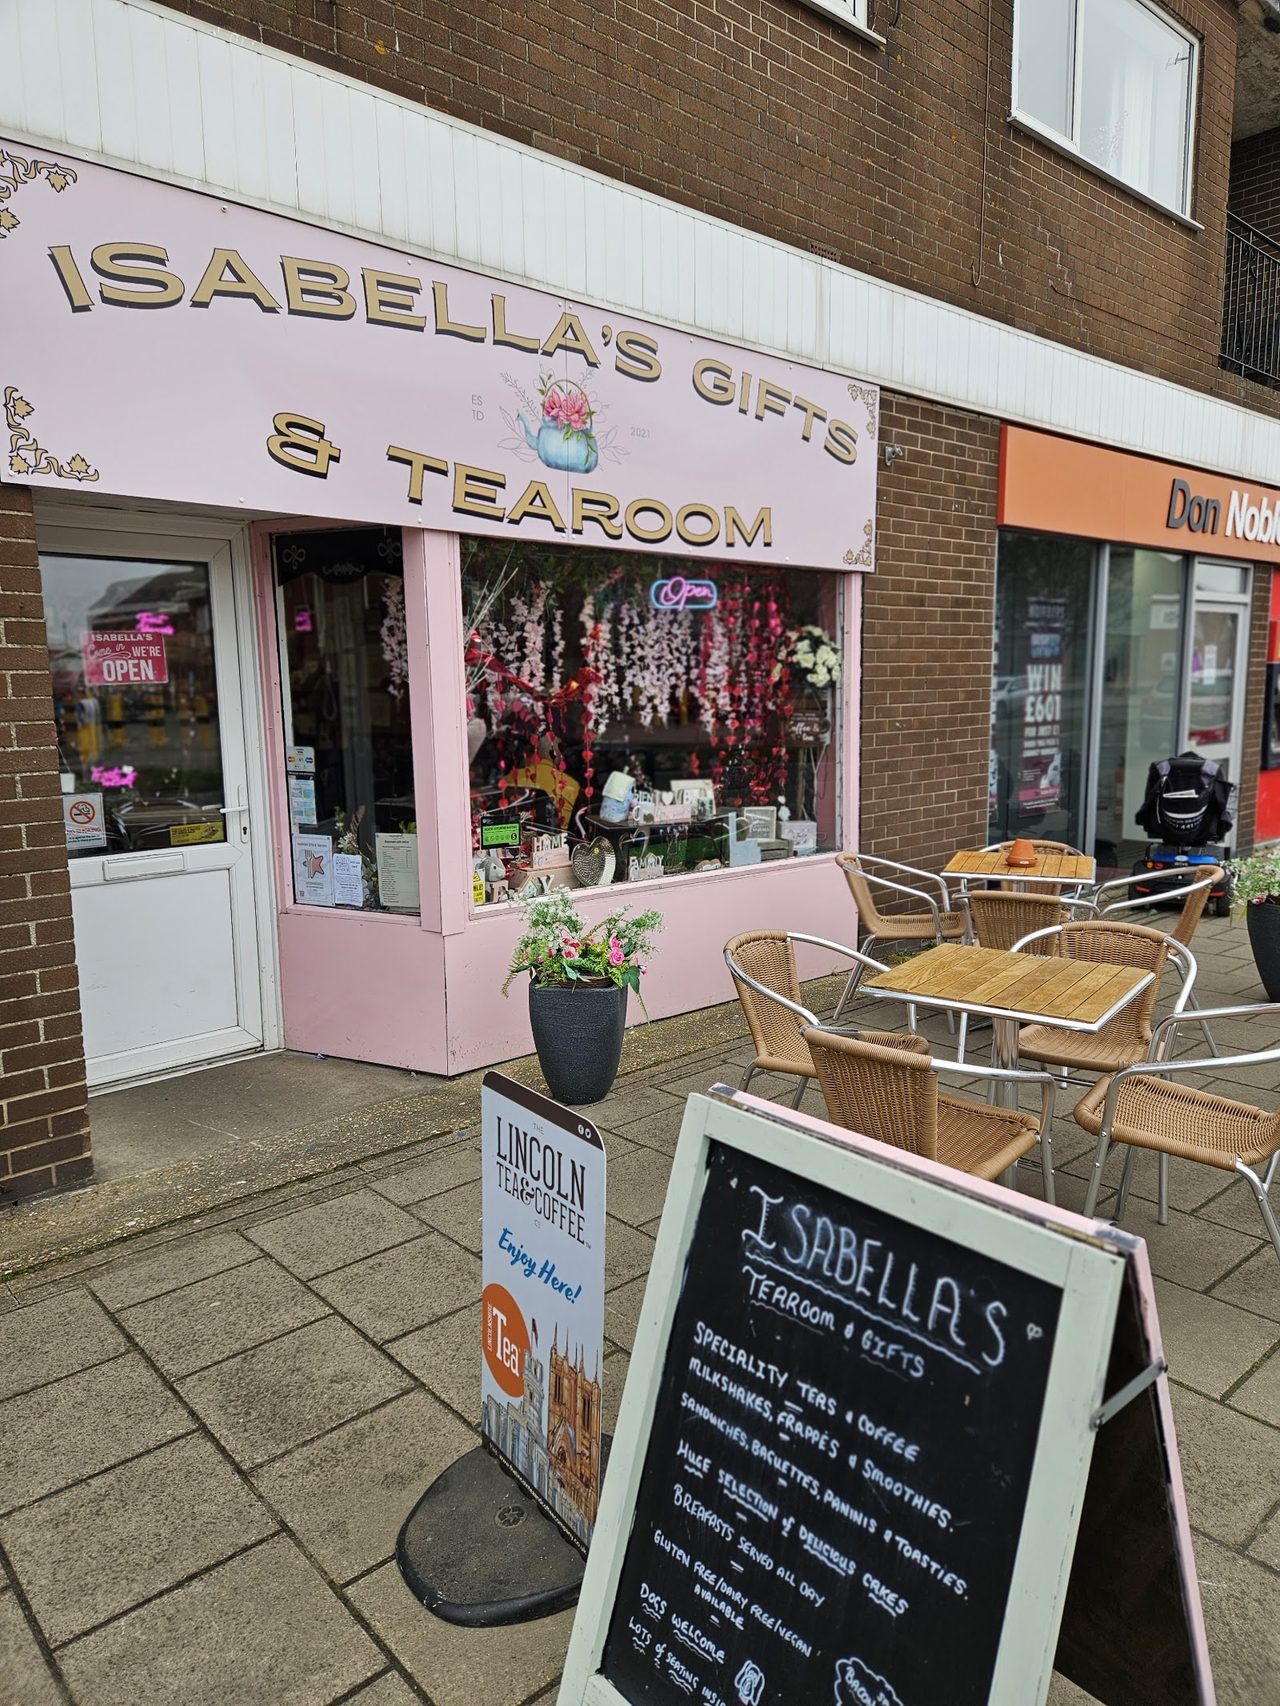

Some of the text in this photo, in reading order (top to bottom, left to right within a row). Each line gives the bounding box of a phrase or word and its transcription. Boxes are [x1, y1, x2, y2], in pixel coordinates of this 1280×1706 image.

[47, 241, 859, 465] ISABELLA'S GIFTS
[630, 426, 651, 438] 2021
[266, 411, 773, 548] & TEAROOM
[1166, 478, 1221, 535] Don
[660, 576, 714, 611] Open
[91, 633, 153, 642] ISABELLA'S
[102, 659, 155, 682] OPEN
[132, 646, 162, 657] WE'RE
[1026, 663, 1062, 692] WIN
[496, 1115, 586, 1212] LINCOLN
[498, 1227, 583, 1304] Enjoy Here!
[492, 1306, 520, 1377] Tea
[742, 1265, 835, 1331] TEAROOM
[861, 1329, 926, 1378] GIFTS
[688, 1356, 774, 1423] MILKSHAKES,
[693, 1320, 789, 1388] SPECIALITY
[796, 1380, 838, 1416] TEAS
[858, 1413, 921, 1462] COFFEE
[676, 1438, 712, 1474] HUGE
[717, 1468, 779, 1521] SELECTION
[798, 1524, 857, 1576] DELICIOUS
[861, 1572, 909, 1615] CAKES
[823, 1488, 878, 1534] PANINIS
[653, 1529, 691, 1568] GLUTEN
[693, 1561, 749, 1610] FREE/DAIRY
[737, 1536, 774, 1571] SERVED
[776, 1566, 797, 1588] ALL
[799, 1581, 826, 1608] DAY
[640, 1582, 726, 1665] DOGS WELCOME
[693, 1583, 745, 1631] AVAILABLE
[628, 1615, 653, 1645] LOTS
[665, 1652, 700, 1689] SEATING
